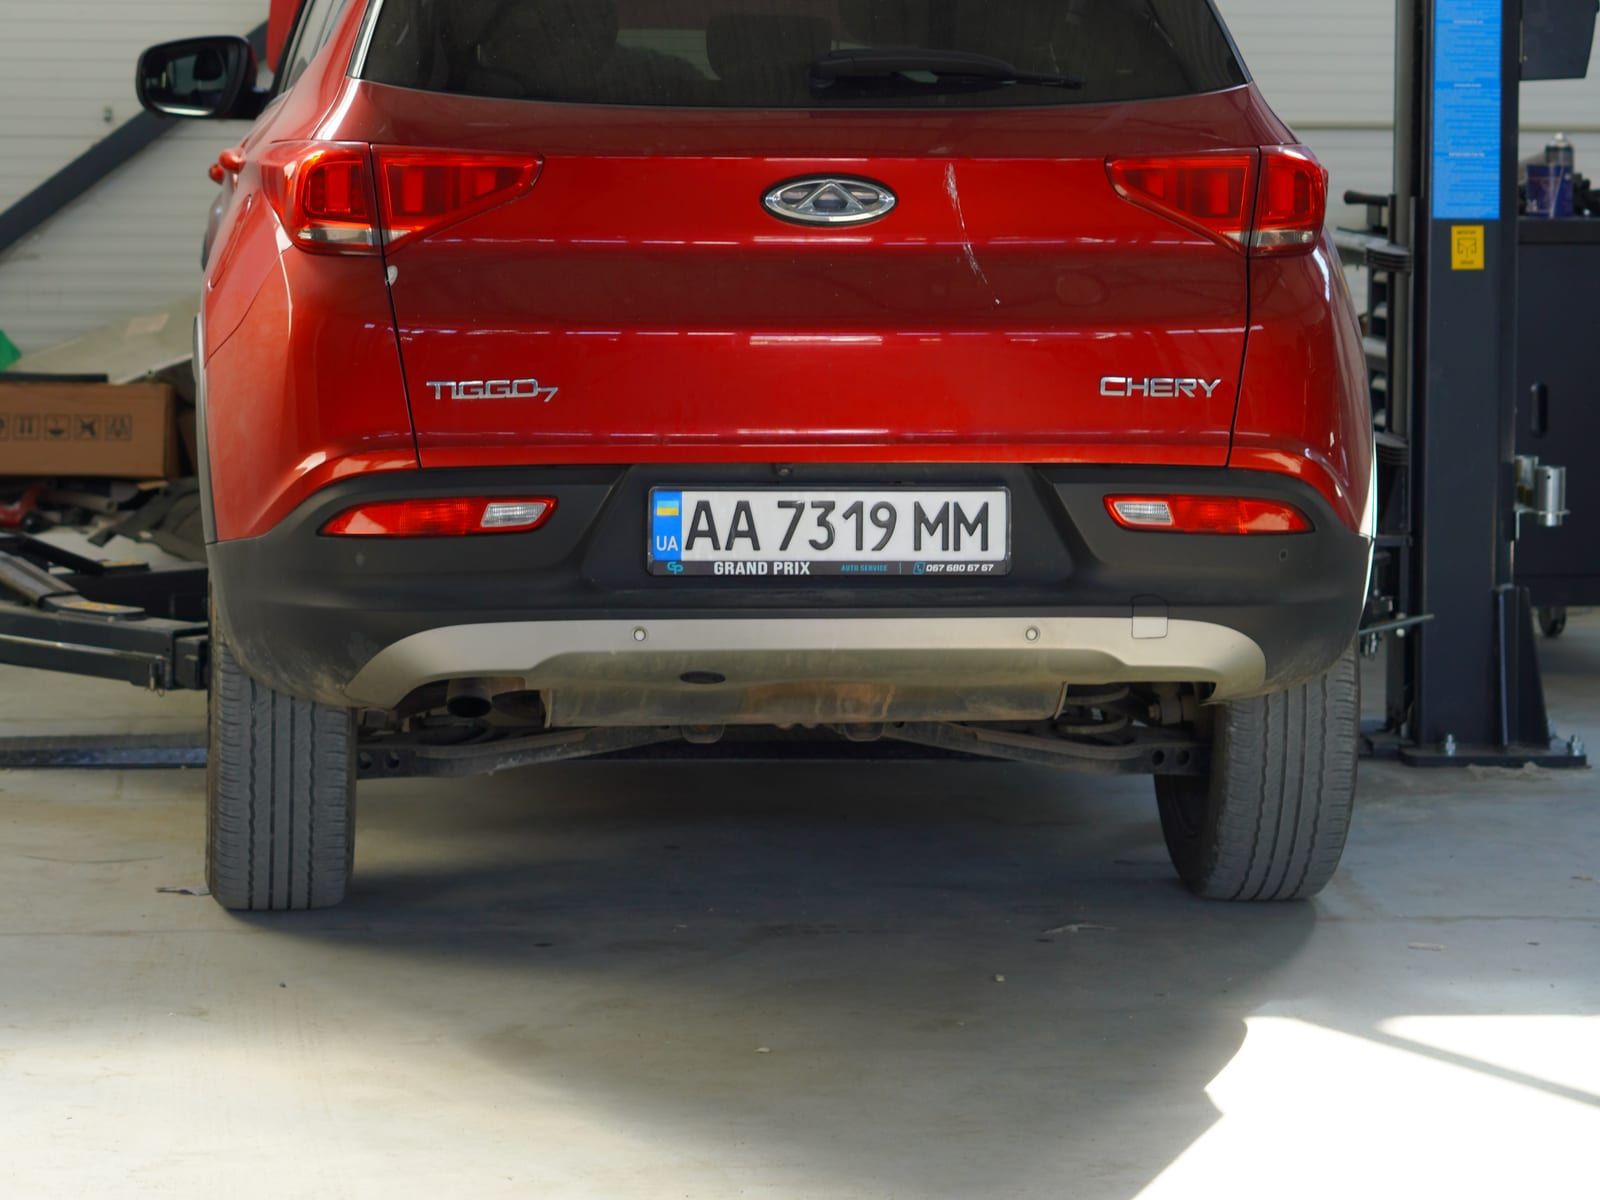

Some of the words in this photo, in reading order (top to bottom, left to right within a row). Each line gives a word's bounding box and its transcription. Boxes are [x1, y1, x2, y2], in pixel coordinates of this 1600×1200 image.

[1100, 376, 1221, 398] CHERY
[685, 500, 761, 551] AA
[777, 500, 898, 552] 7319
[913, 500, 989, 552] MM
[656, 536, 679, 551] UA
[713, 561, 768, 576] GRAND
[773, 561, 811, 576] PRIX
[841, 564, 859, 573] AUTO
[860, 564, 888, 573] SERVICE
[926, 563, 945, 573] 067
[946, 563, 965, 573] 680
[967, 563, 980, 573] 67
[981, 563, 994, 573] 67
